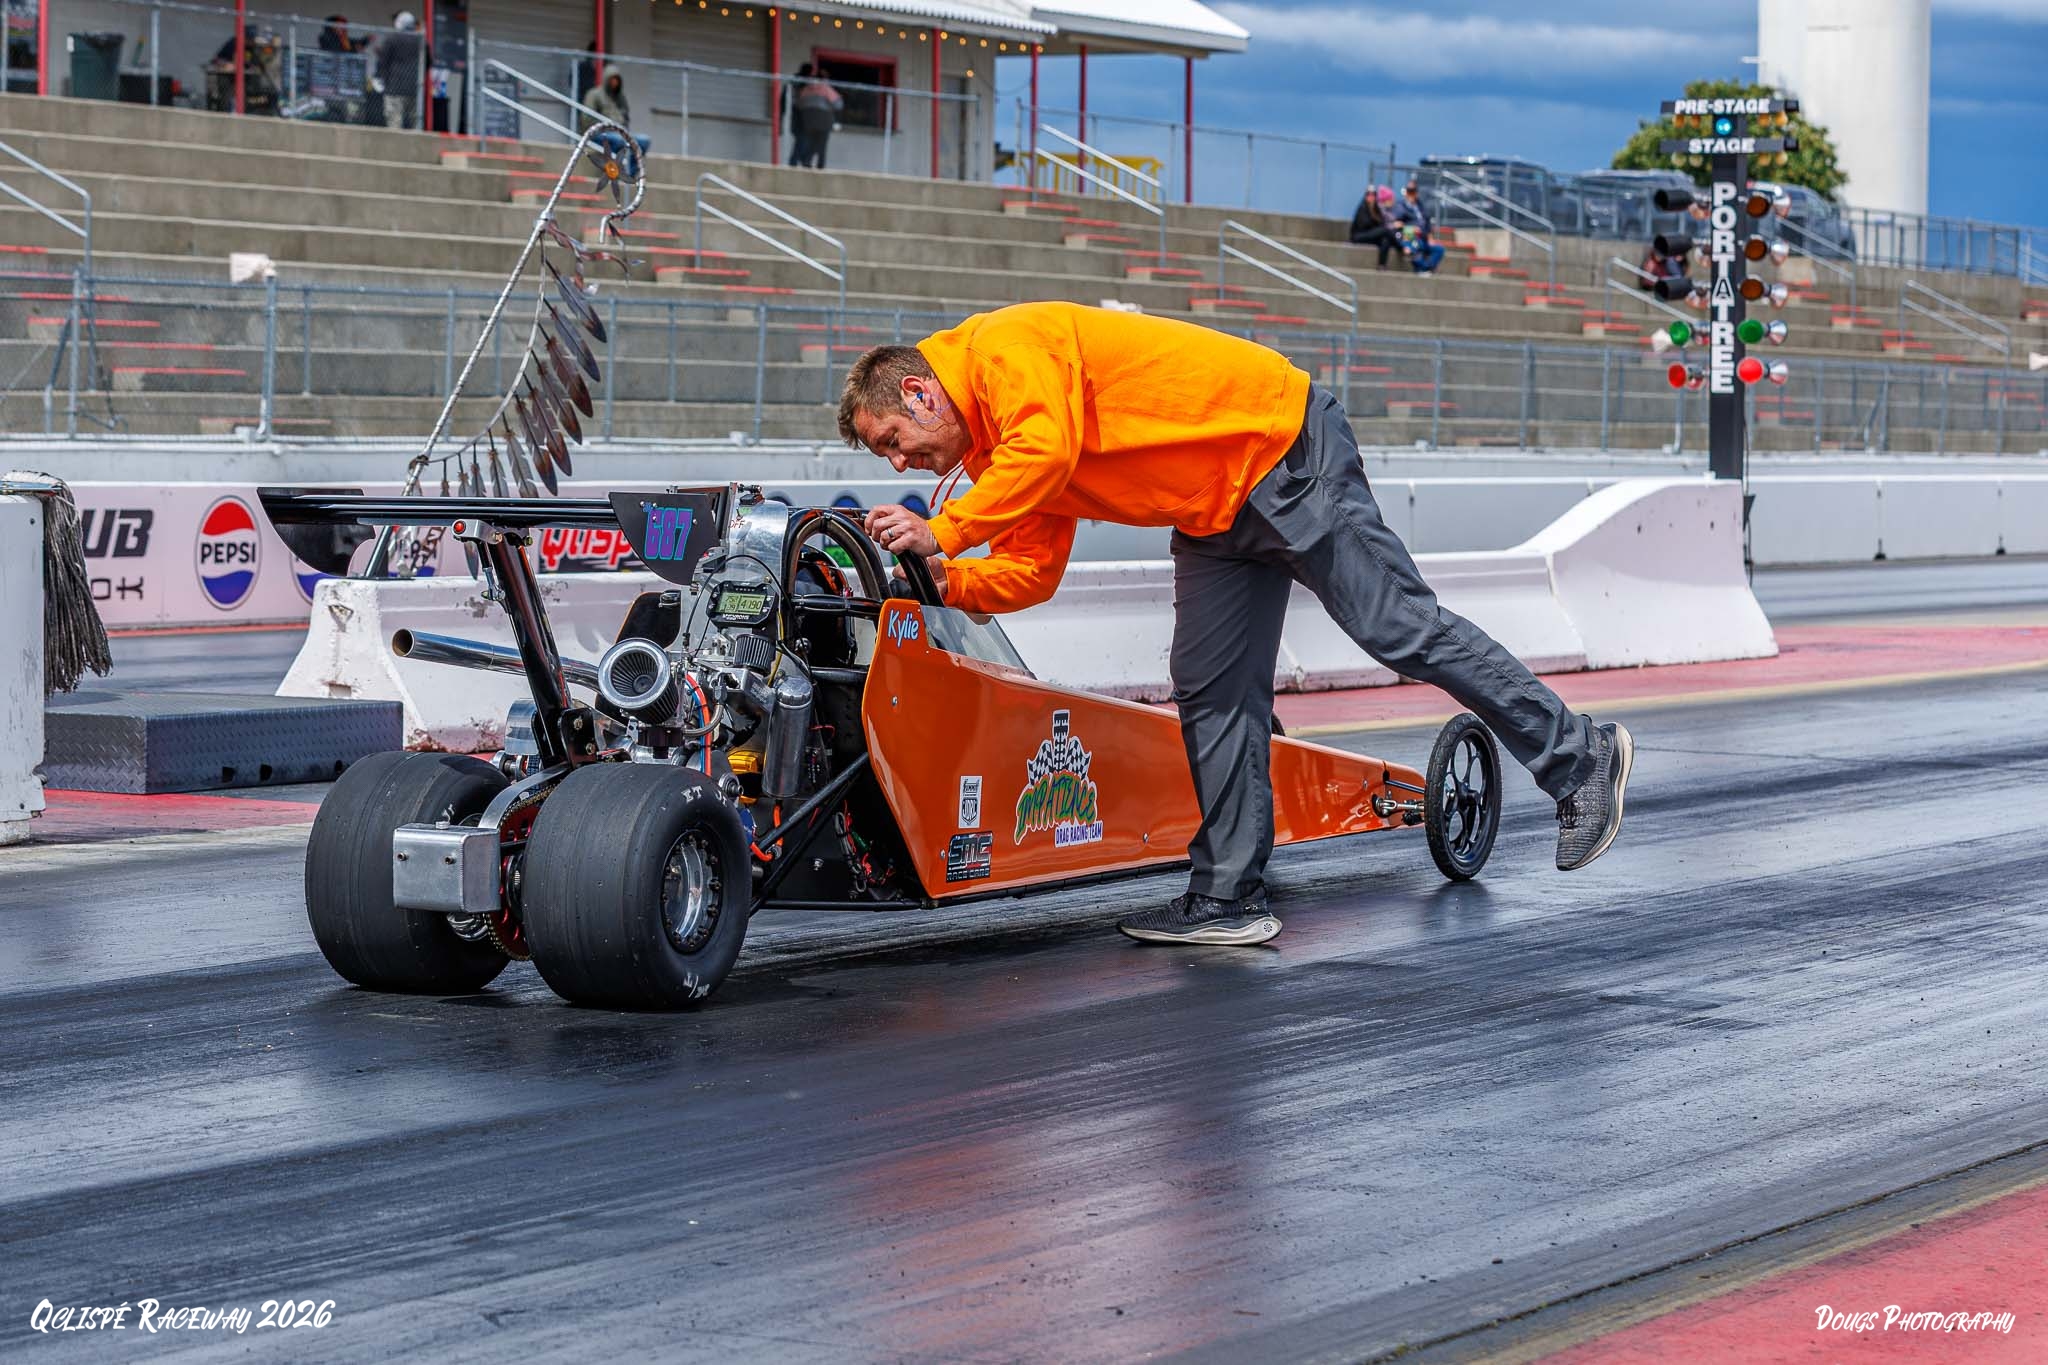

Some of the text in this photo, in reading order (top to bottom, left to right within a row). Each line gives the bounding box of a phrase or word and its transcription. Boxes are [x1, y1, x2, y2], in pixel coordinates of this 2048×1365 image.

[1674, 98, 1770, 115] PRE-STAGE
[1688, 138, 1756, 153] STAGE
[644, 506, 693, 560] 687
[200, 542, 256, 564] PEPSI
[888, 608, 919, 647] Kylie
[1056, 822, 1102, 845] DRAG RACING TEAM
